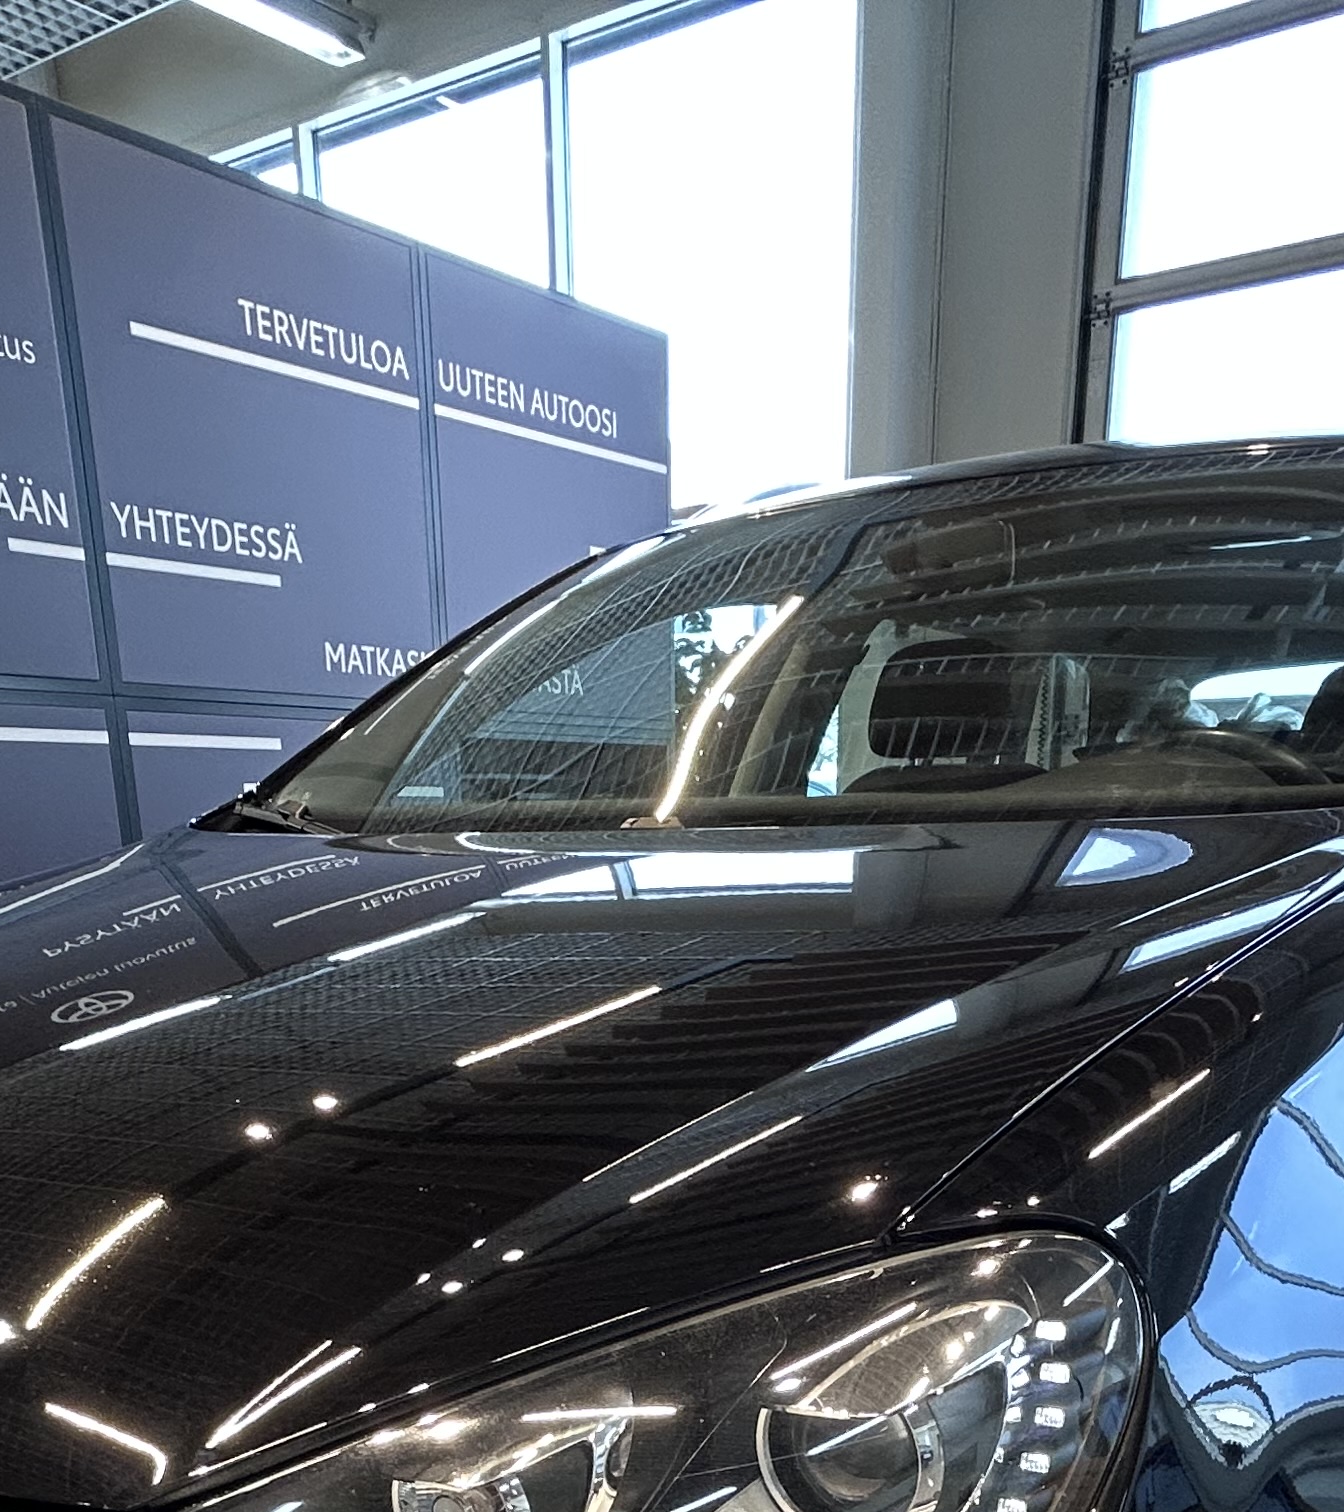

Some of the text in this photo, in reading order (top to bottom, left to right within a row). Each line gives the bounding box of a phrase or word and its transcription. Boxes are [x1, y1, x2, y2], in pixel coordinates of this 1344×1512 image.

[237, 298, 618, 439] TERVETULOA UUTEEN AUTOOSI
[110, 501, 303, 564] YHTEYDESSÄ
